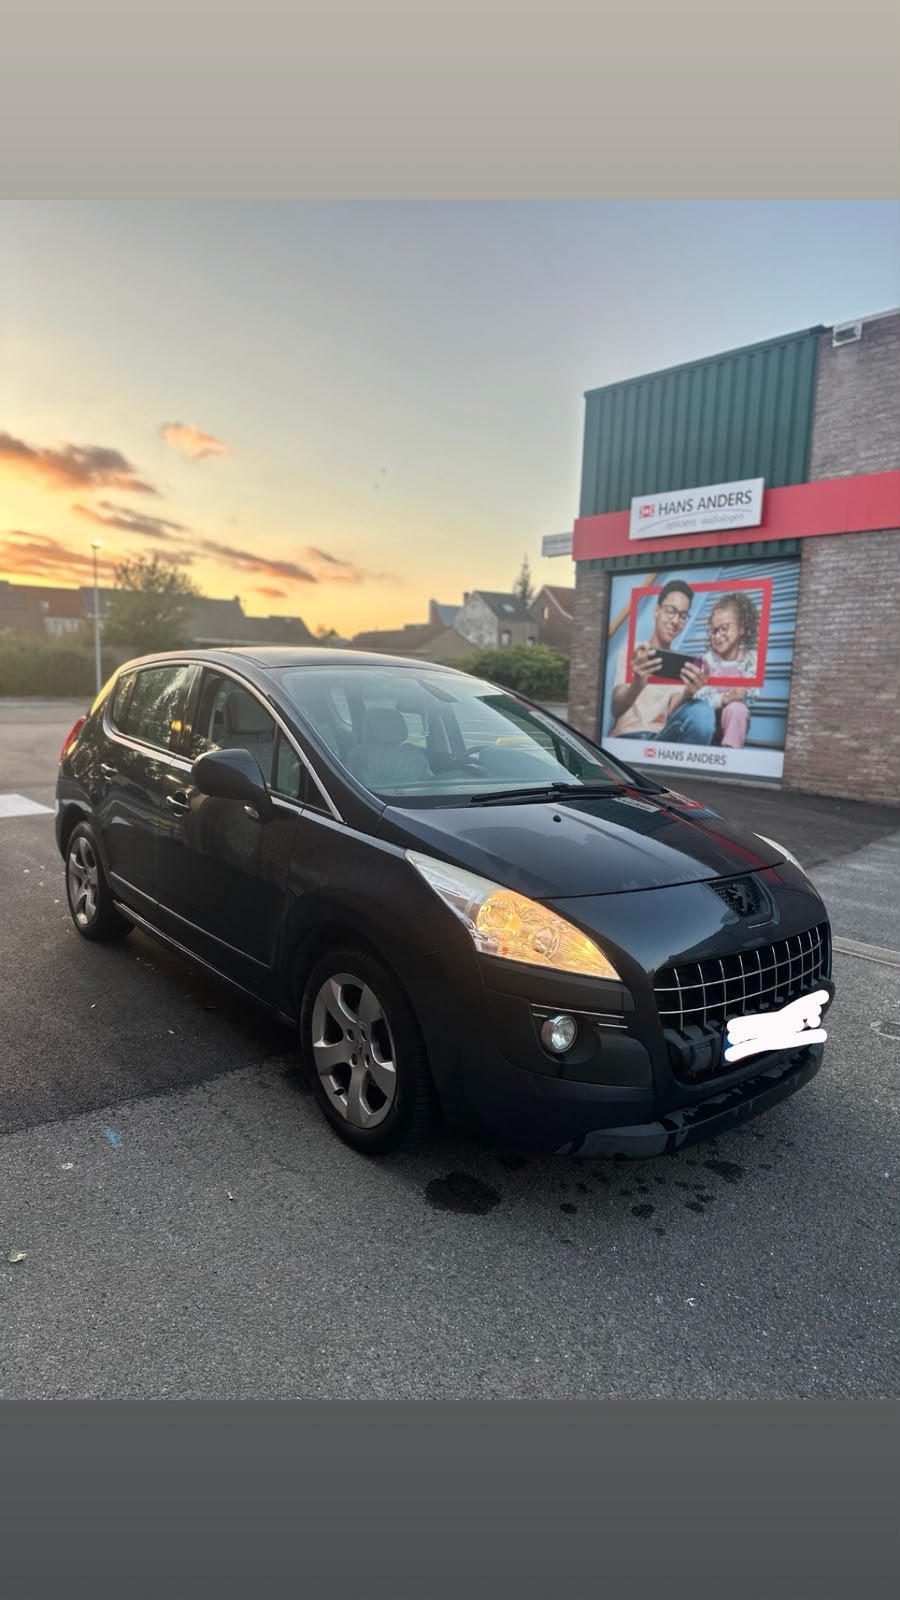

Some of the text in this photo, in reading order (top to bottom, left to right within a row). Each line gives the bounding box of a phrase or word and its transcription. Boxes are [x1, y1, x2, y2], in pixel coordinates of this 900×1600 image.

[658, 490, 752, 516] HANS ANDERS
[658, 749, 727, 766] HANS ANDERS
